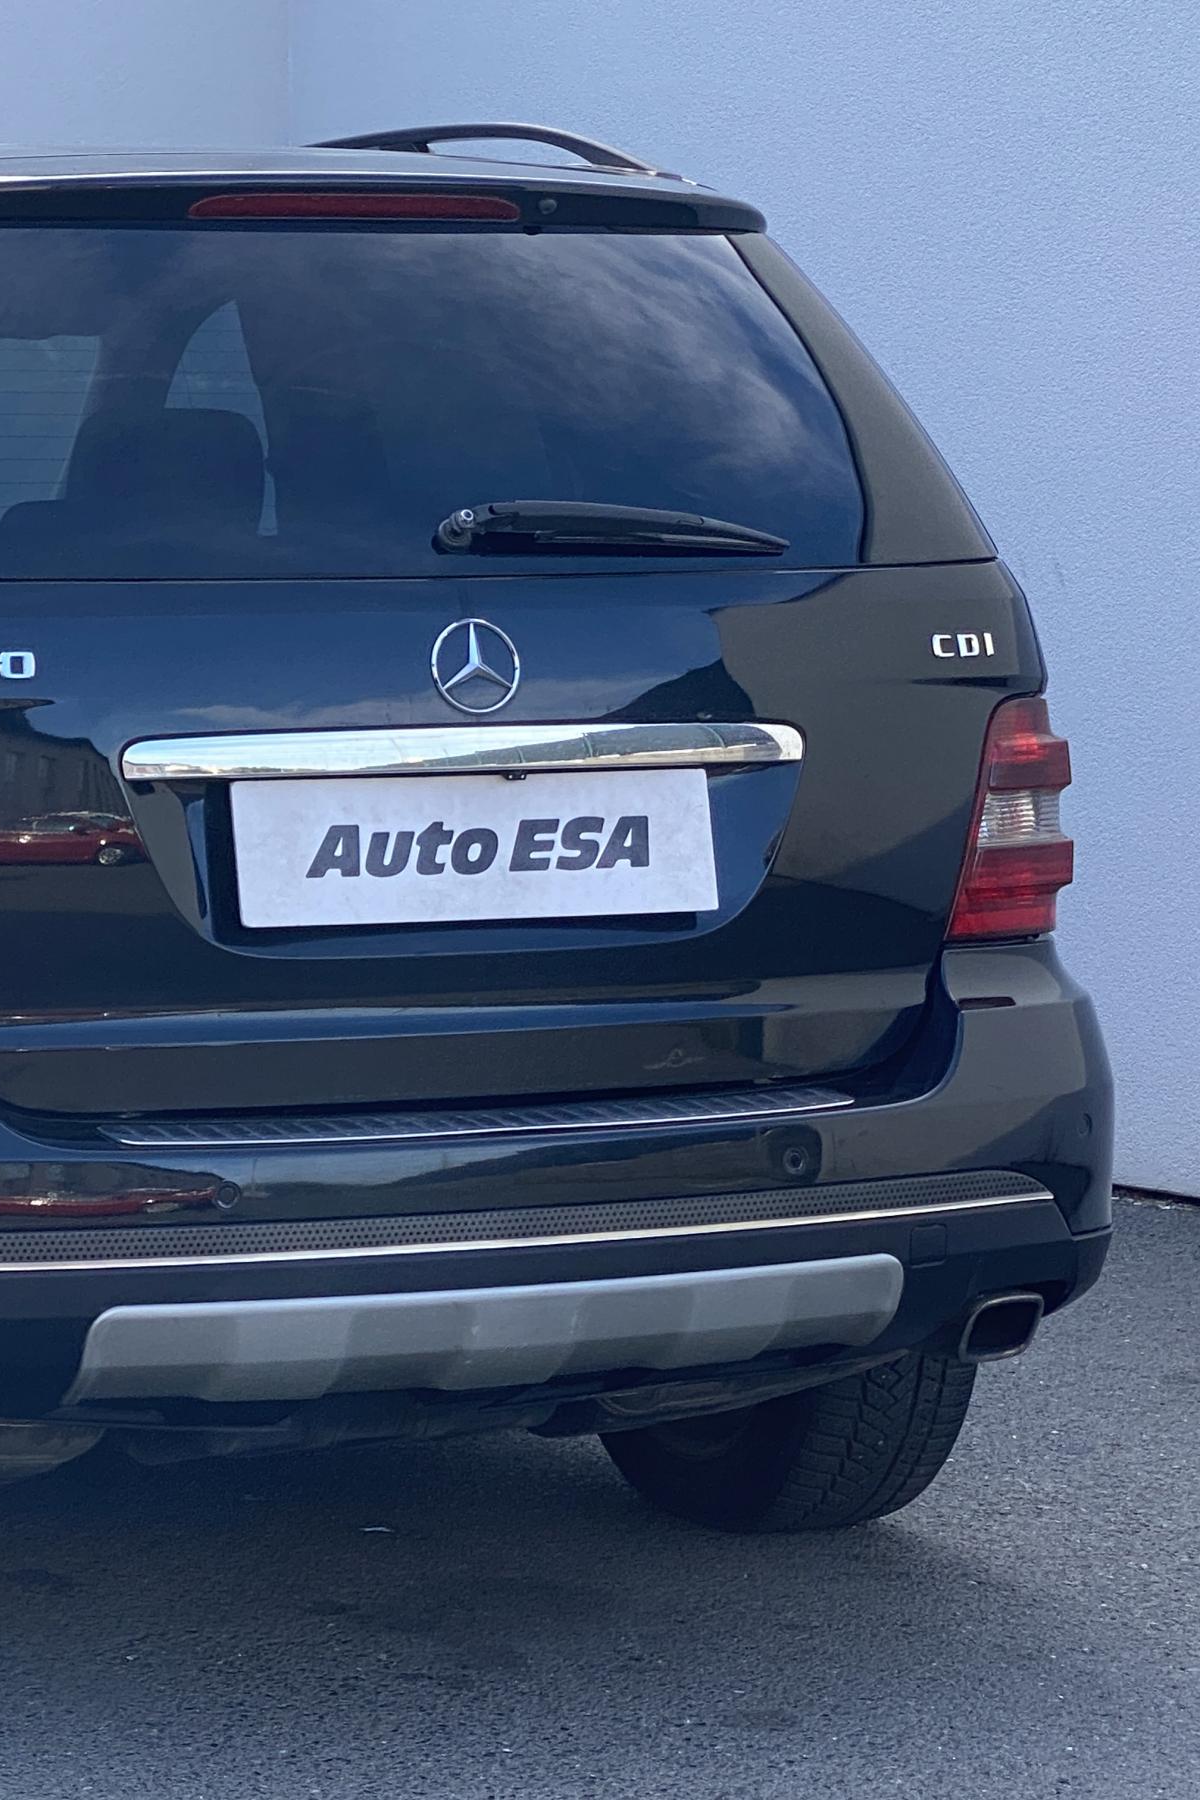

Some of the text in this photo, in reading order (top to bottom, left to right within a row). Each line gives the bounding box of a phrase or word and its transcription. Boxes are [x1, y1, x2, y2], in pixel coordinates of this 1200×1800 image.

[931, 632, 995, 658] CDI
[305, 815, 650, 878] Auto ESA
